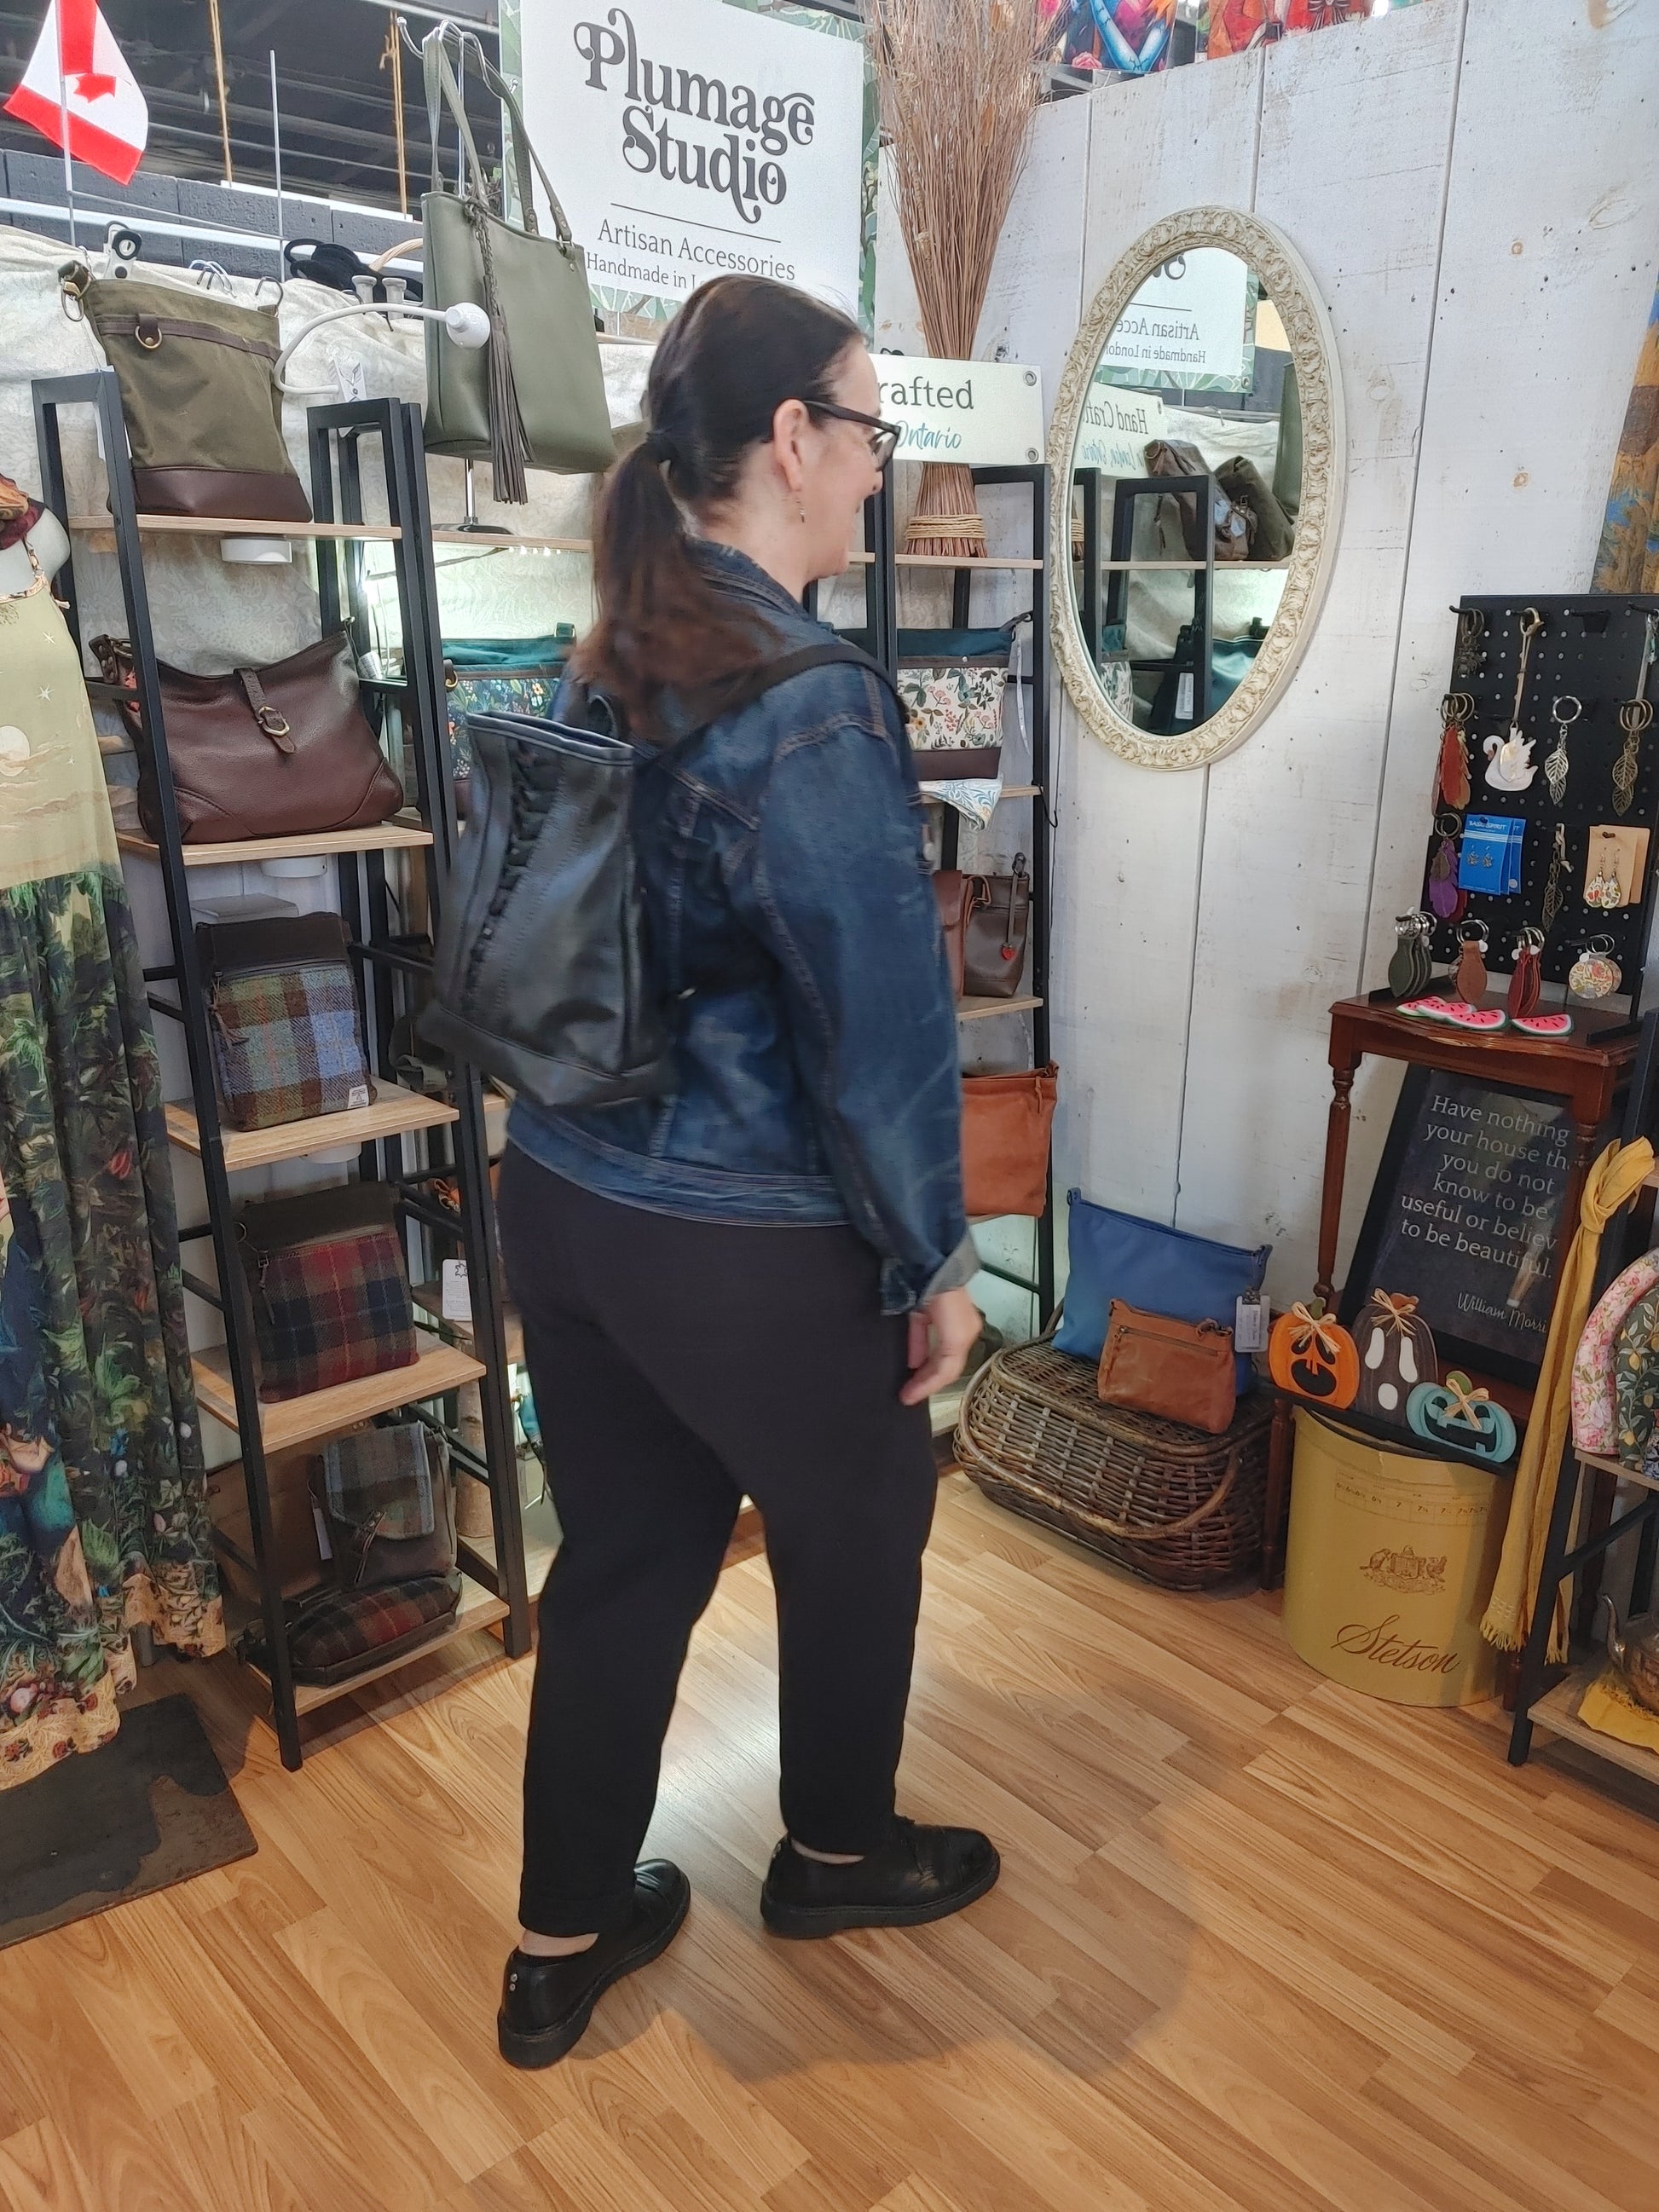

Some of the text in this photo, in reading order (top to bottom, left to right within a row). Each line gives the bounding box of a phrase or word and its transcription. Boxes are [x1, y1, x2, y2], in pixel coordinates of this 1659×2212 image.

[574, 8, 815, 156] Plumage
[622, 105, 787, 223] Studio
[587, 252, 669, 285] Handmade
[673, 270, 688, 288] in
[597, 218, 795, 280] Artisan Accessories
[878, 376, 974, 410] rafted
[895, 420, 962, 450] Ontario
[1431, 1095, 1570, 1147] Have nothing
[1423, 1123, 1569, 1171] your house th
[1432, 1172, 1548, 1220] know to be
[1440, 1154, 1555, 1194] you do not
[1401, 1195, 1558, 1250] useful or believ
[1401, 1219, 1552, 1279] to be beautiful.
[1457, 1291, 1546, 1334] William Morri
[1330, 1614, 1462, 1674] Stetson
